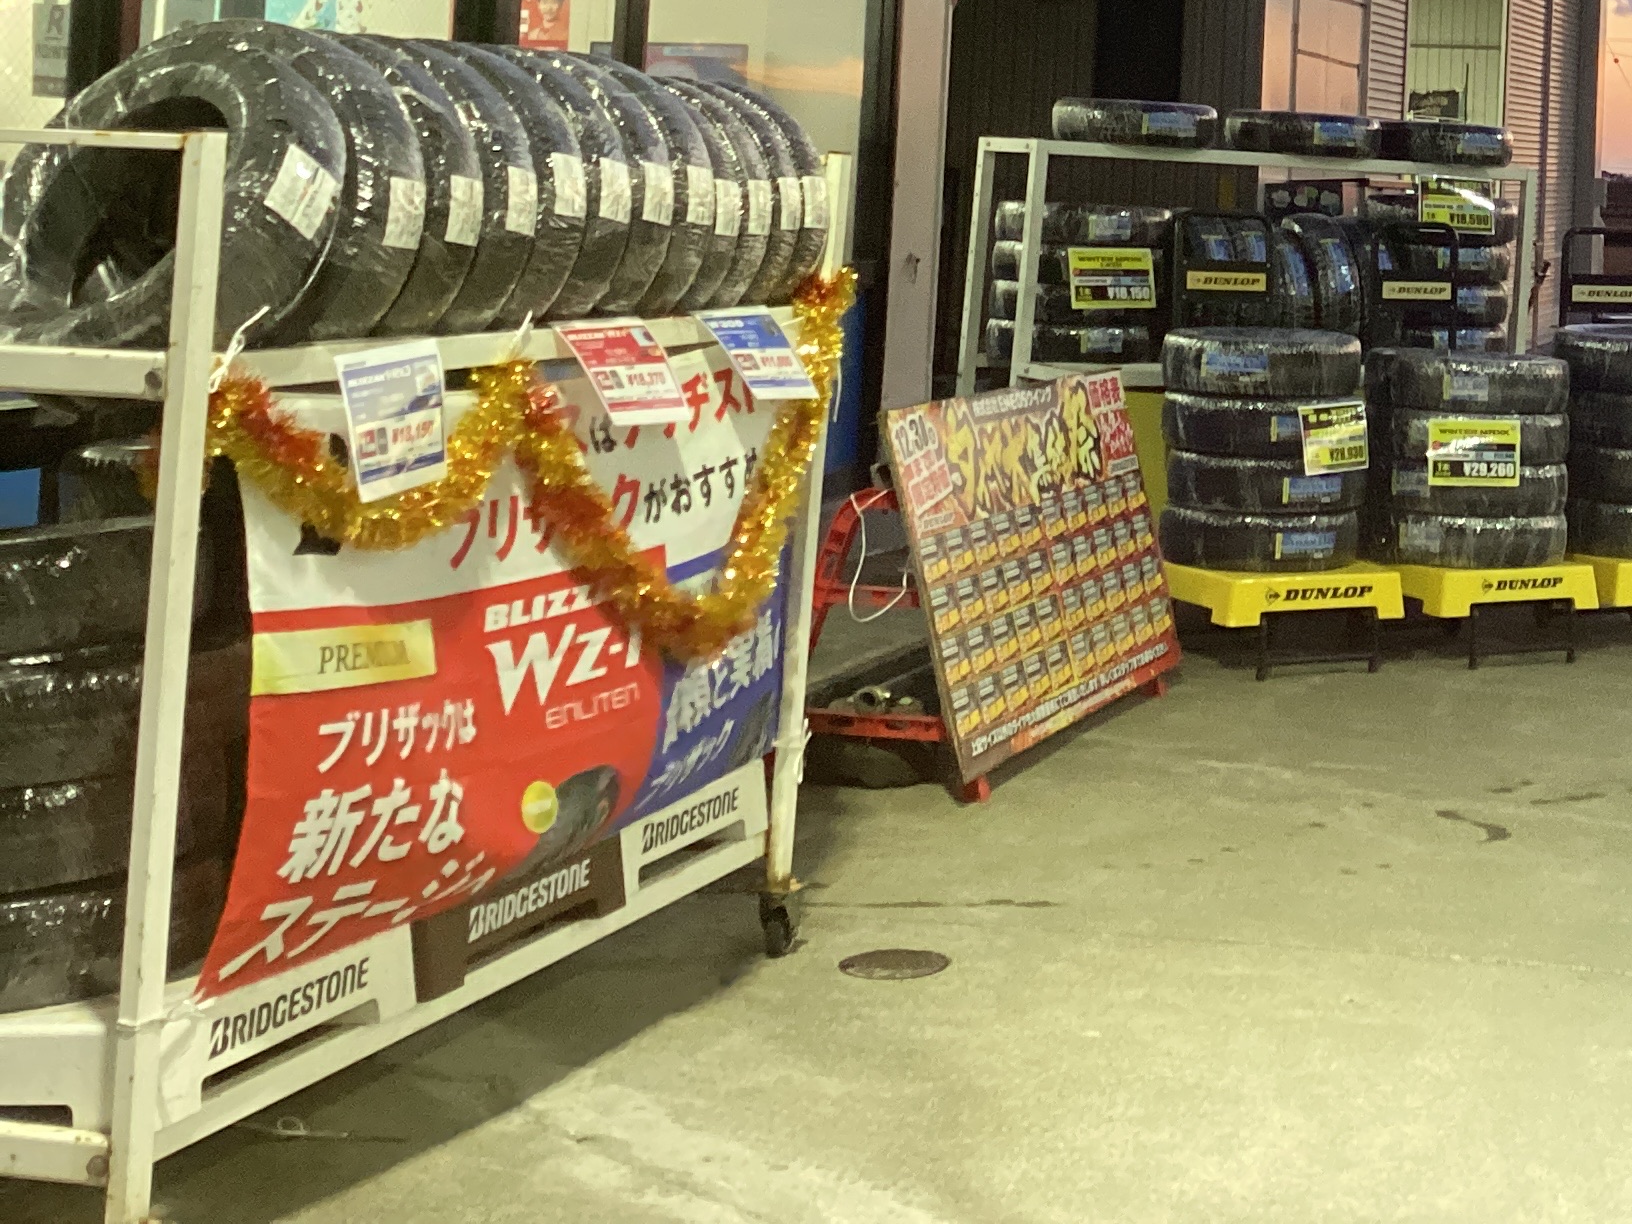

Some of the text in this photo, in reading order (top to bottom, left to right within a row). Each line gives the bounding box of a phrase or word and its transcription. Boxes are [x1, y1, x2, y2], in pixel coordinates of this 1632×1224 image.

[1202, 277, 1261, 287] DUNLOP
[1398, 285, 1448, 295] DUNLOP
[1462, 461, 1515, 478] ¥29,260
[1283, 584, 1374, 602] DUNLOP
[1495, 576, 1564, 591] DUNLOP
[545, 682, 641, 729] ENLITEN
[317, 699, 477, 774] ブリザックは
[276, 768, 466, 884] 新たな
[642, 787, 740, 854] BRIDGESTONE
[468, 858, 590, 943] BRIDGESTONE
[208, 956, 370, 1059] BRIDGESTONE
